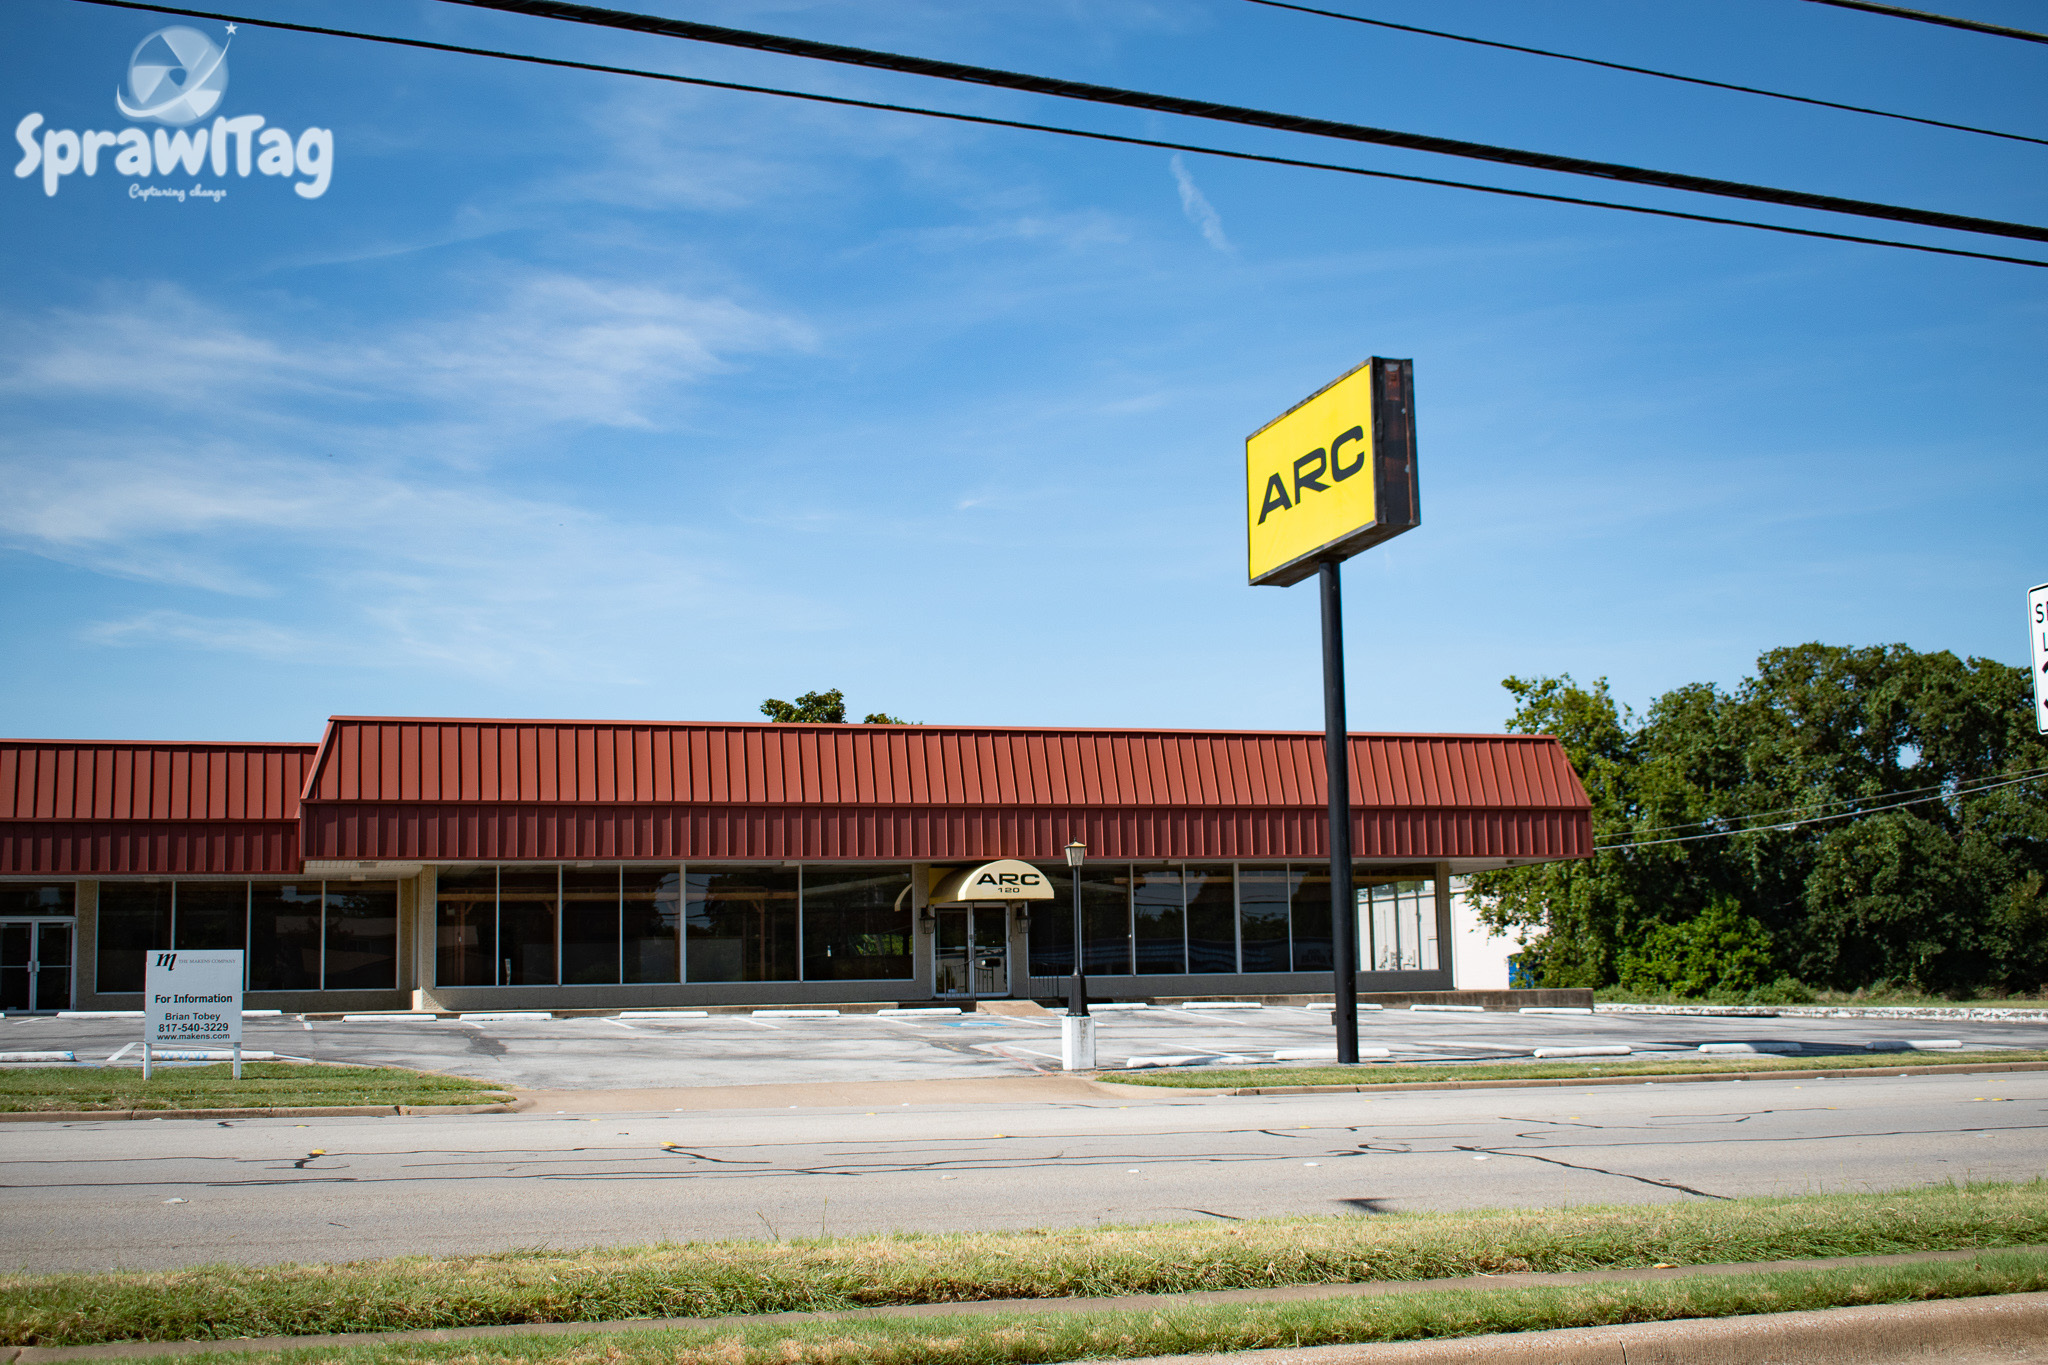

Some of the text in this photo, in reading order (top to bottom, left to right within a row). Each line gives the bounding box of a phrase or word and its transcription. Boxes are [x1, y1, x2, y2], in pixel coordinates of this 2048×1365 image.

[1257, 425, 1365, 526] ARC
[976, 873, 1040, 886] ARC
[155, 994, 233, 1004] For Information
[165, 1012, 221, 1021] Brian Tobey
[158, 1023, 229, 1032] 817-540-3229
